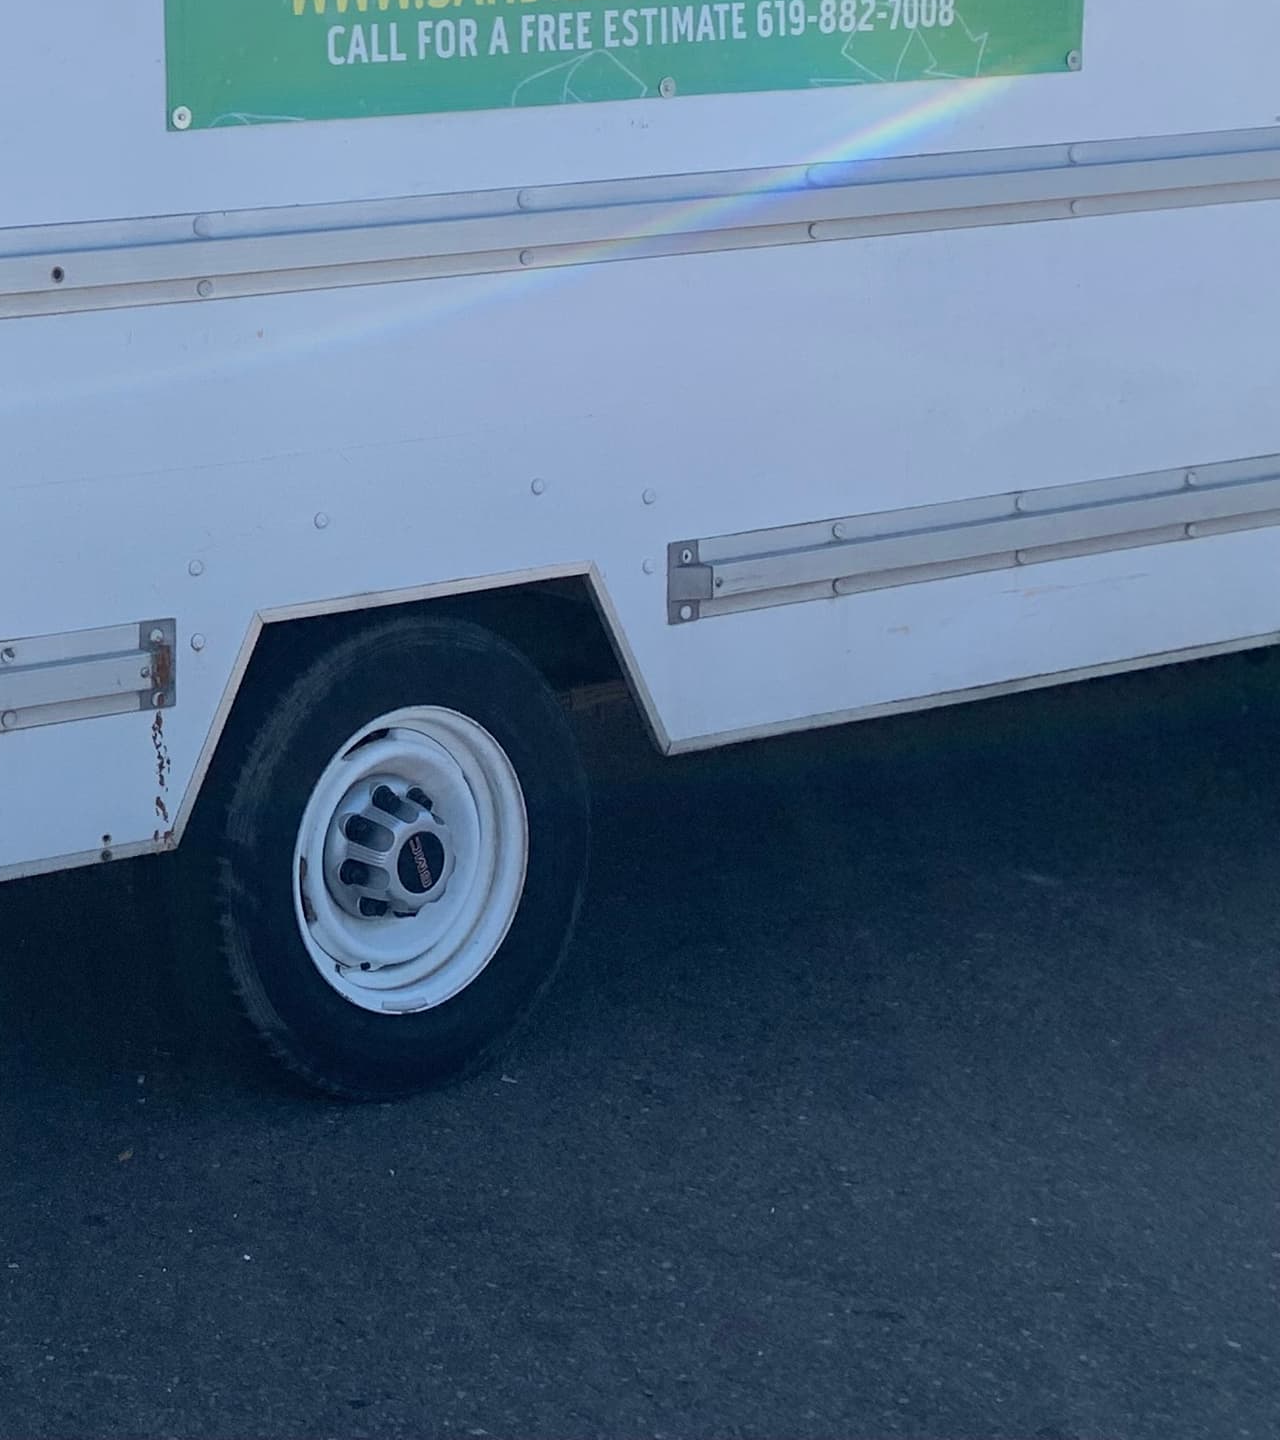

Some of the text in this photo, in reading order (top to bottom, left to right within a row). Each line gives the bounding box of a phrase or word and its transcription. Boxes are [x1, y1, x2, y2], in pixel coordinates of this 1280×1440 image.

[327, 22, 408, 66] CALL
[417, 17, 479, 60] FOR
[488, 16, 510, 56] A
[521, 11, 593, 54] FREE
[604, 1, 747, 49] ESTIMATE
[408, 835, 433, 889] GMC
